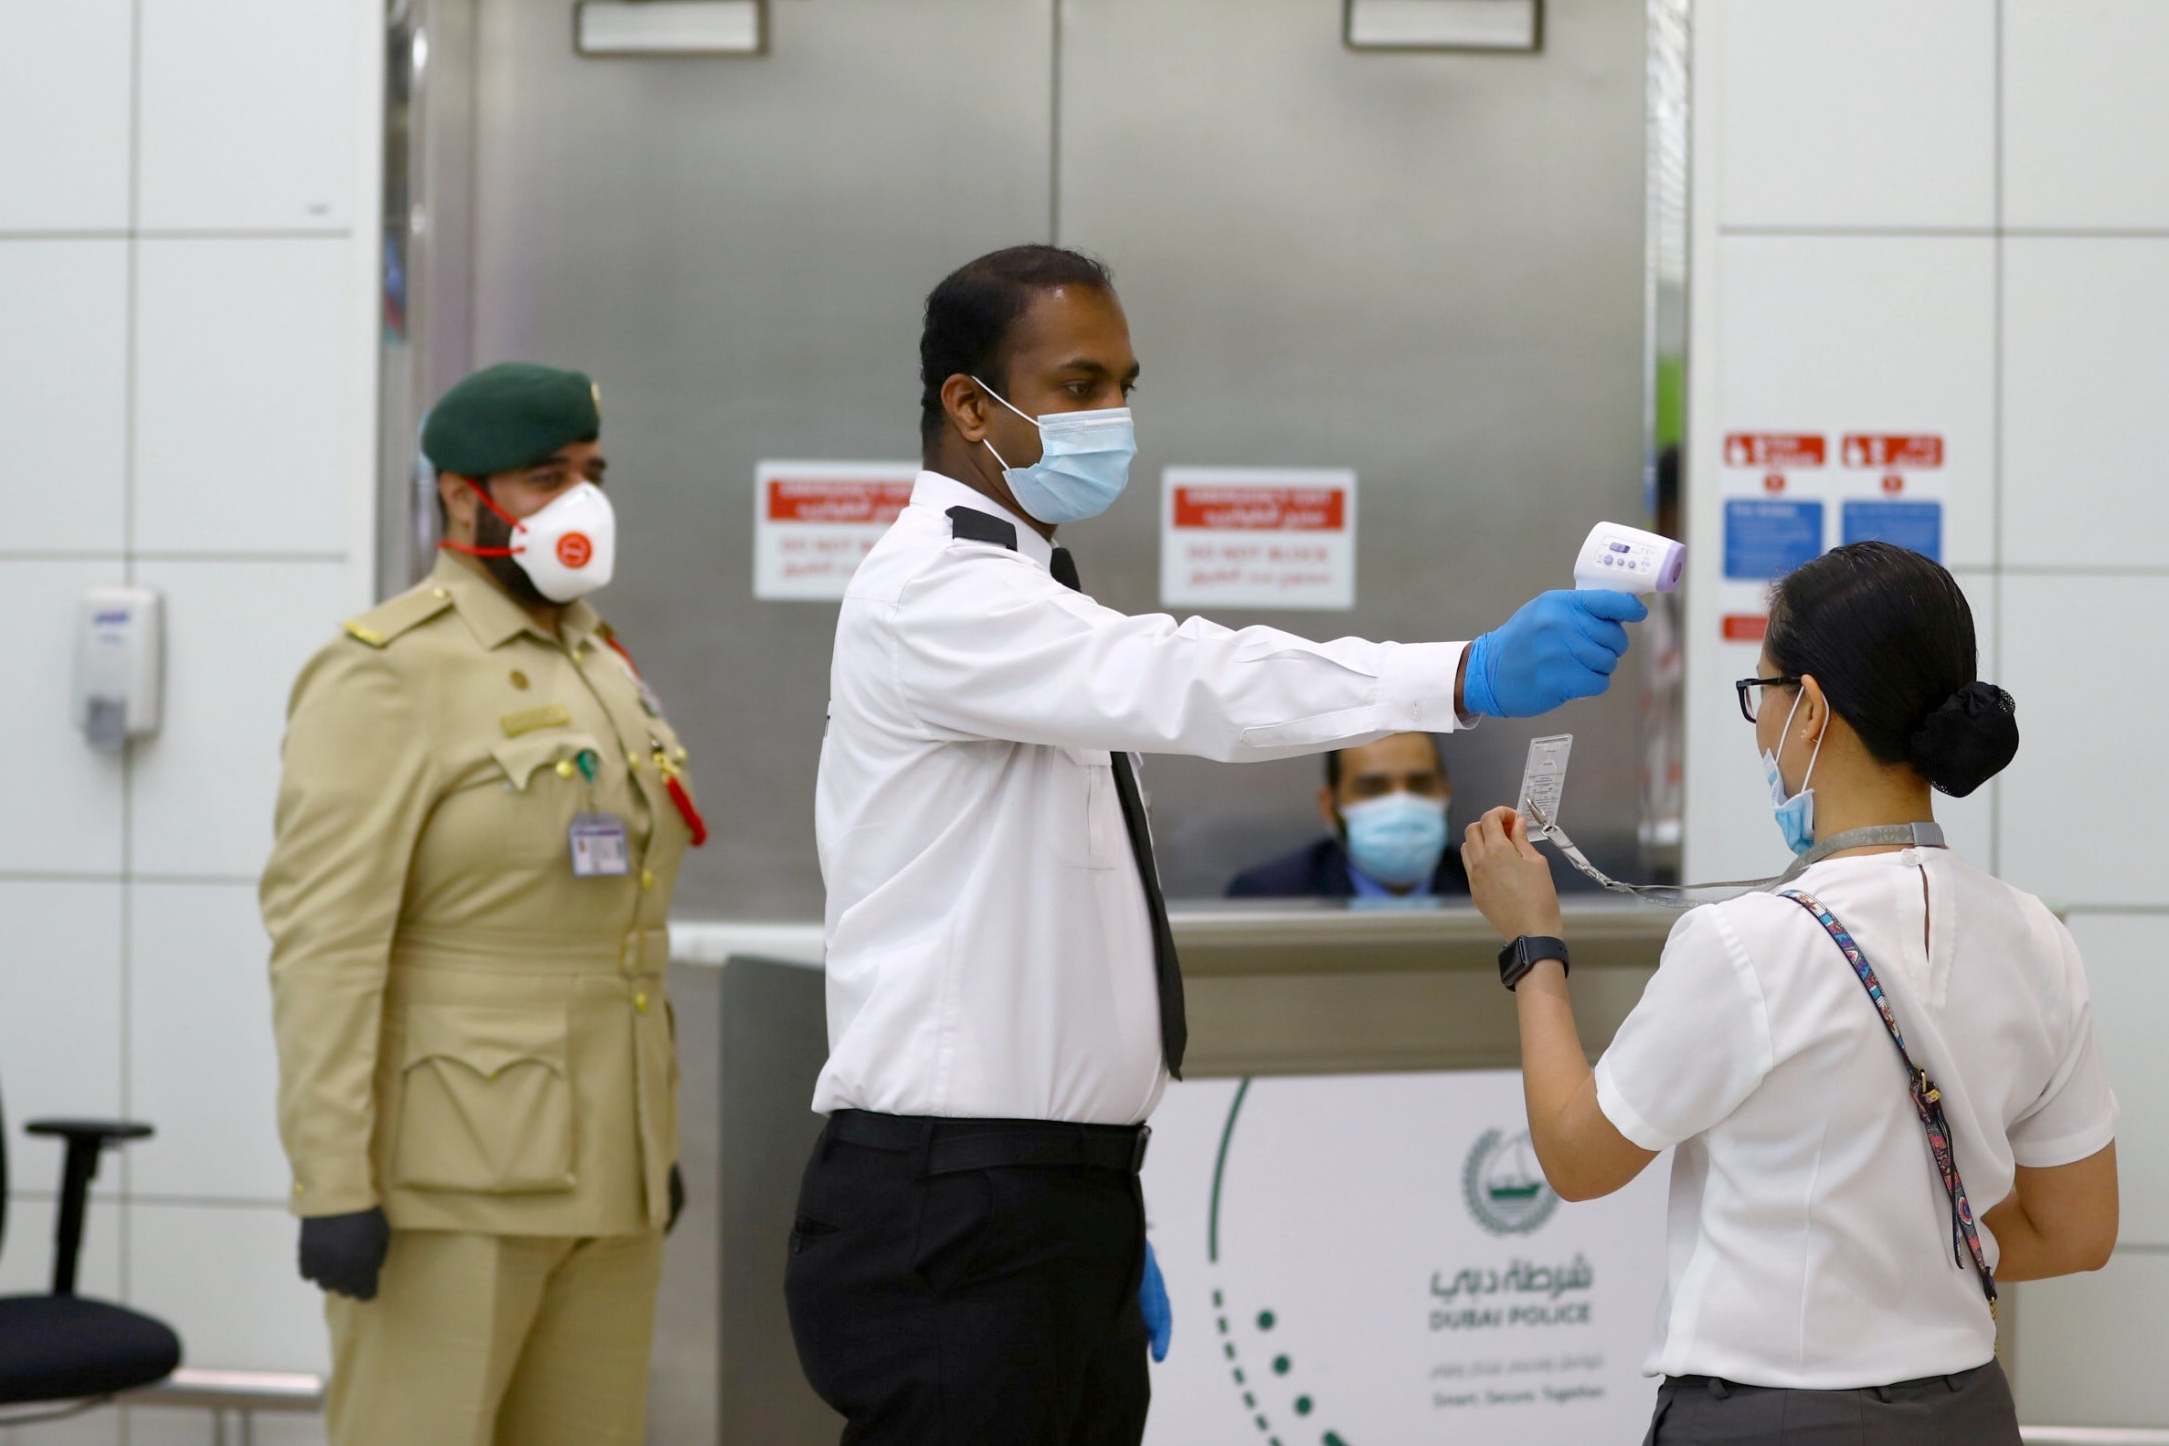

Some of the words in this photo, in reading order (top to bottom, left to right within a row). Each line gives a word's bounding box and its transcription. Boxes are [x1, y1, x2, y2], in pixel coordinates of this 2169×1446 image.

[1429, 1266, 1499, 1304] دبي
[1502, 1252, 1593, 1300] شرطة
[1428, 1308, 1502, 1332] DUBAI
[1508, 1301, 1591, 1327] POLICE
